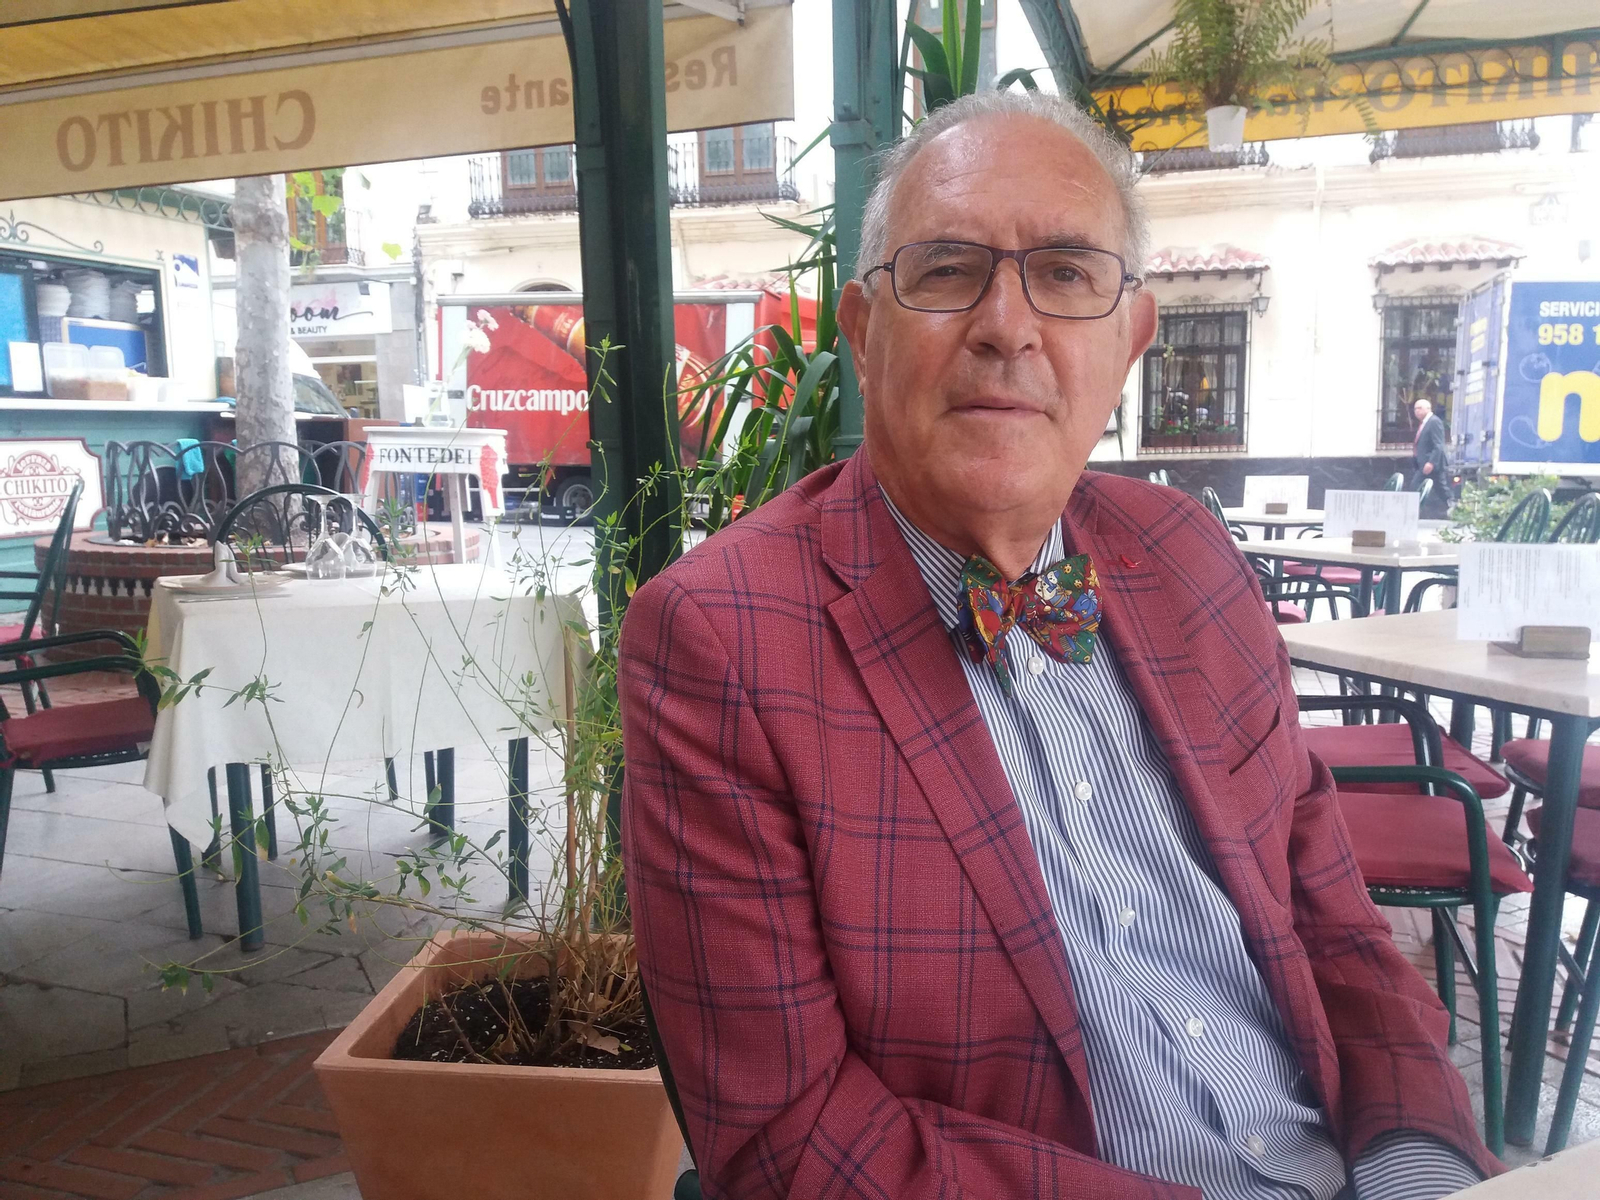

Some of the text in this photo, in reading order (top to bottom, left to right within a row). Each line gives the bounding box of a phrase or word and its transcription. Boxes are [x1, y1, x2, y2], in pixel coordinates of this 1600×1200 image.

[297, 326, 328, 335] BEAUTY
[1538, 323, 1584, 346] 958
[466, 384, 589, 416] Cruzcampo
[4, 478, 68, 496] CHIKITO
